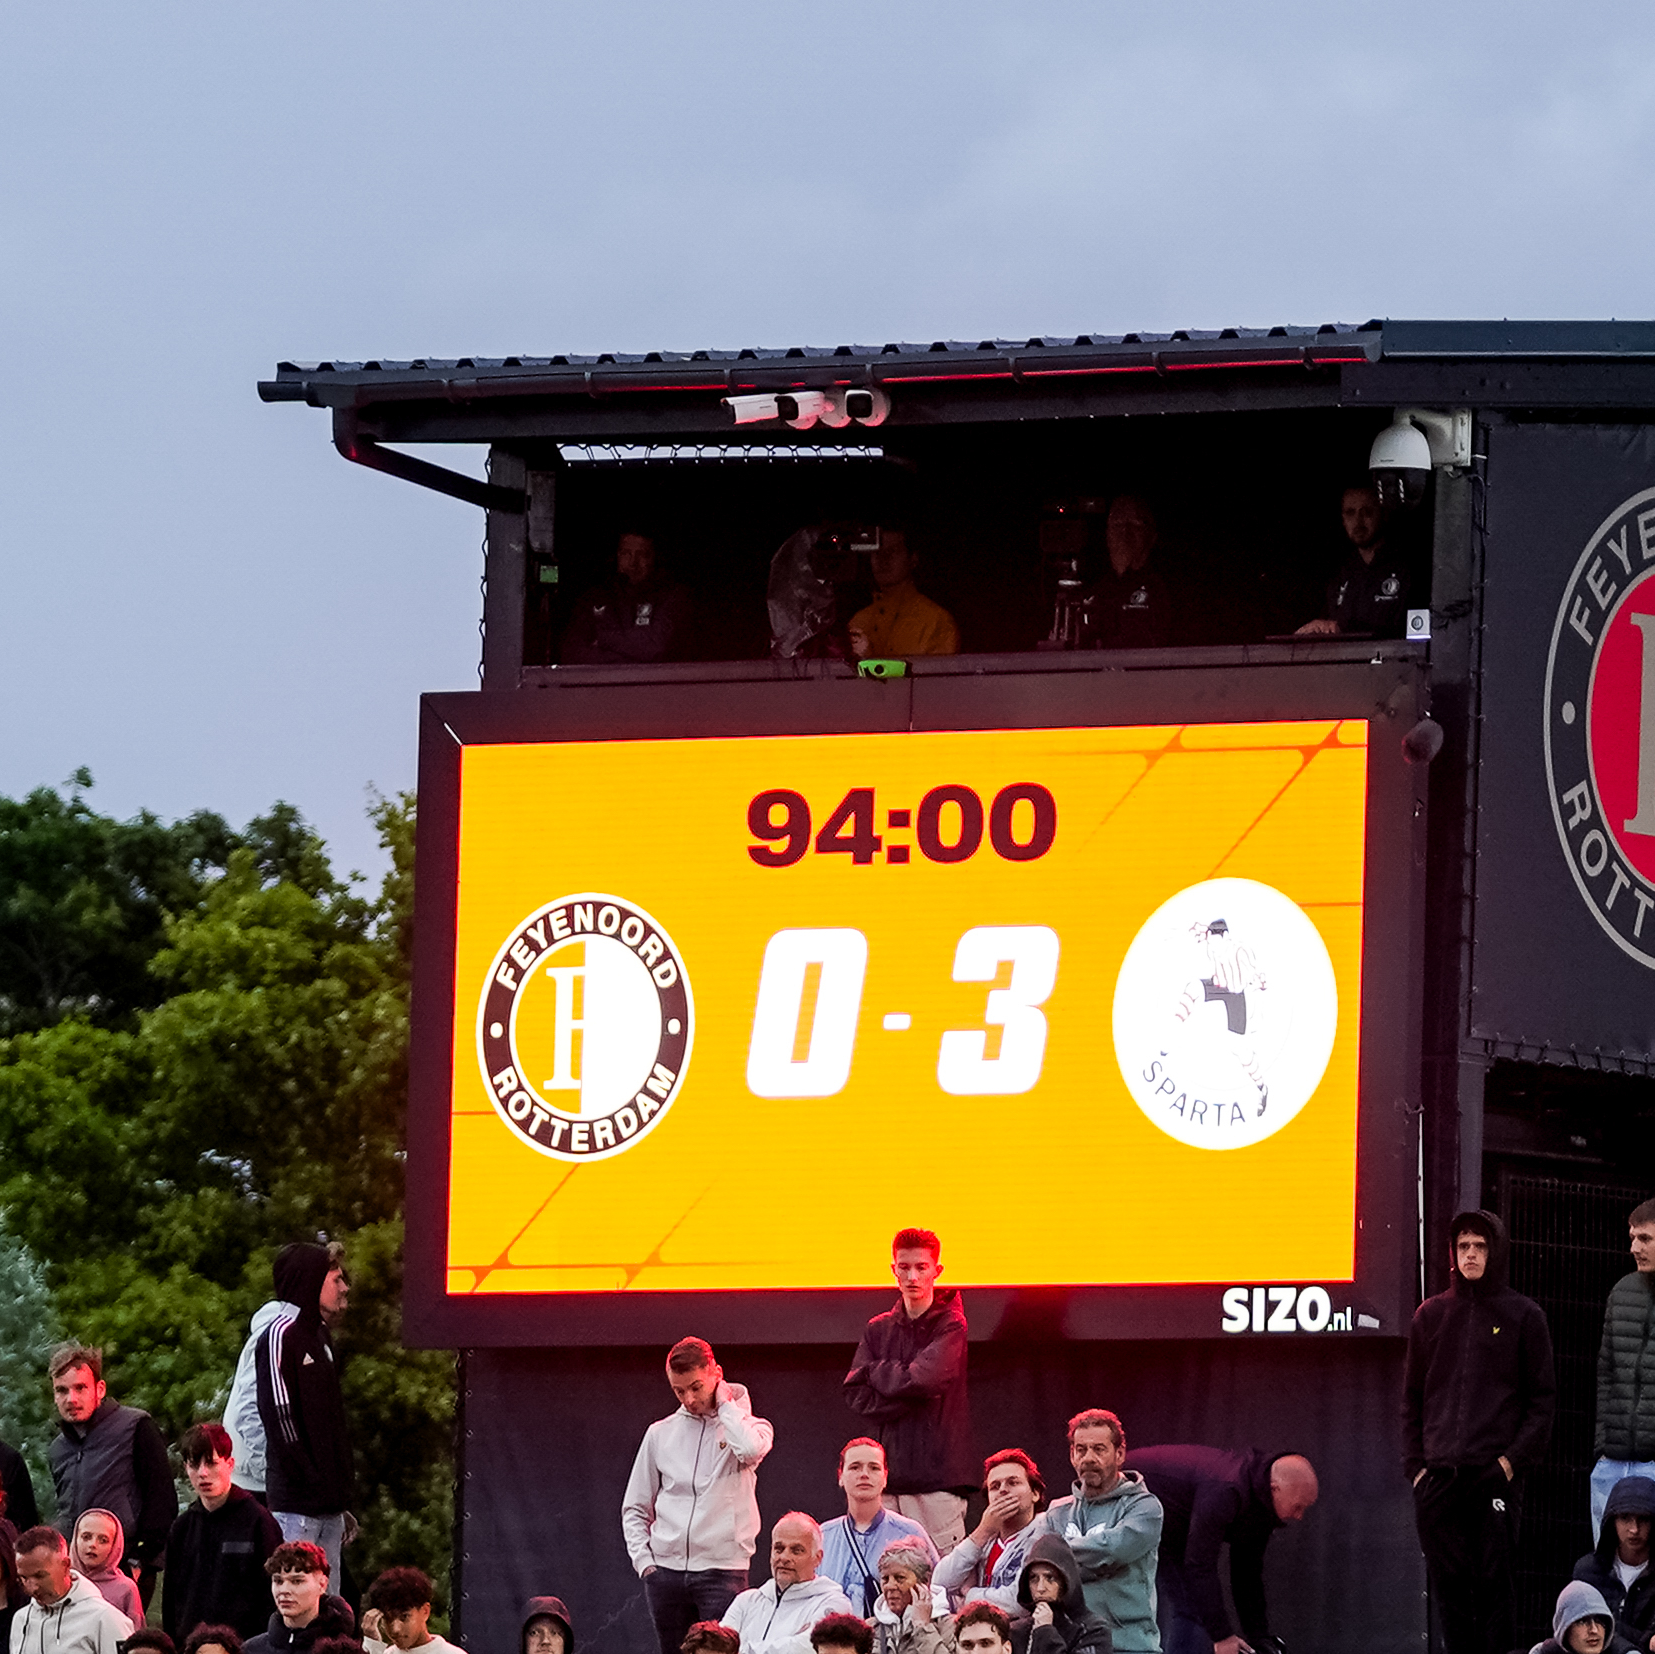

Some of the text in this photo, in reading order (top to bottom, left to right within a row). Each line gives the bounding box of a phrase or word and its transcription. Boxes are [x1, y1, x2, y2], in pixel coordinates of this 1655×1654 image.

[746, 781, 1058, 868] 94:00
[495, 902, 678, 991] FEYENOORD
[492, 1062, 676, 1152] ROTTERDAM
[1142, 1060, 1246, 1127] SPARTA
